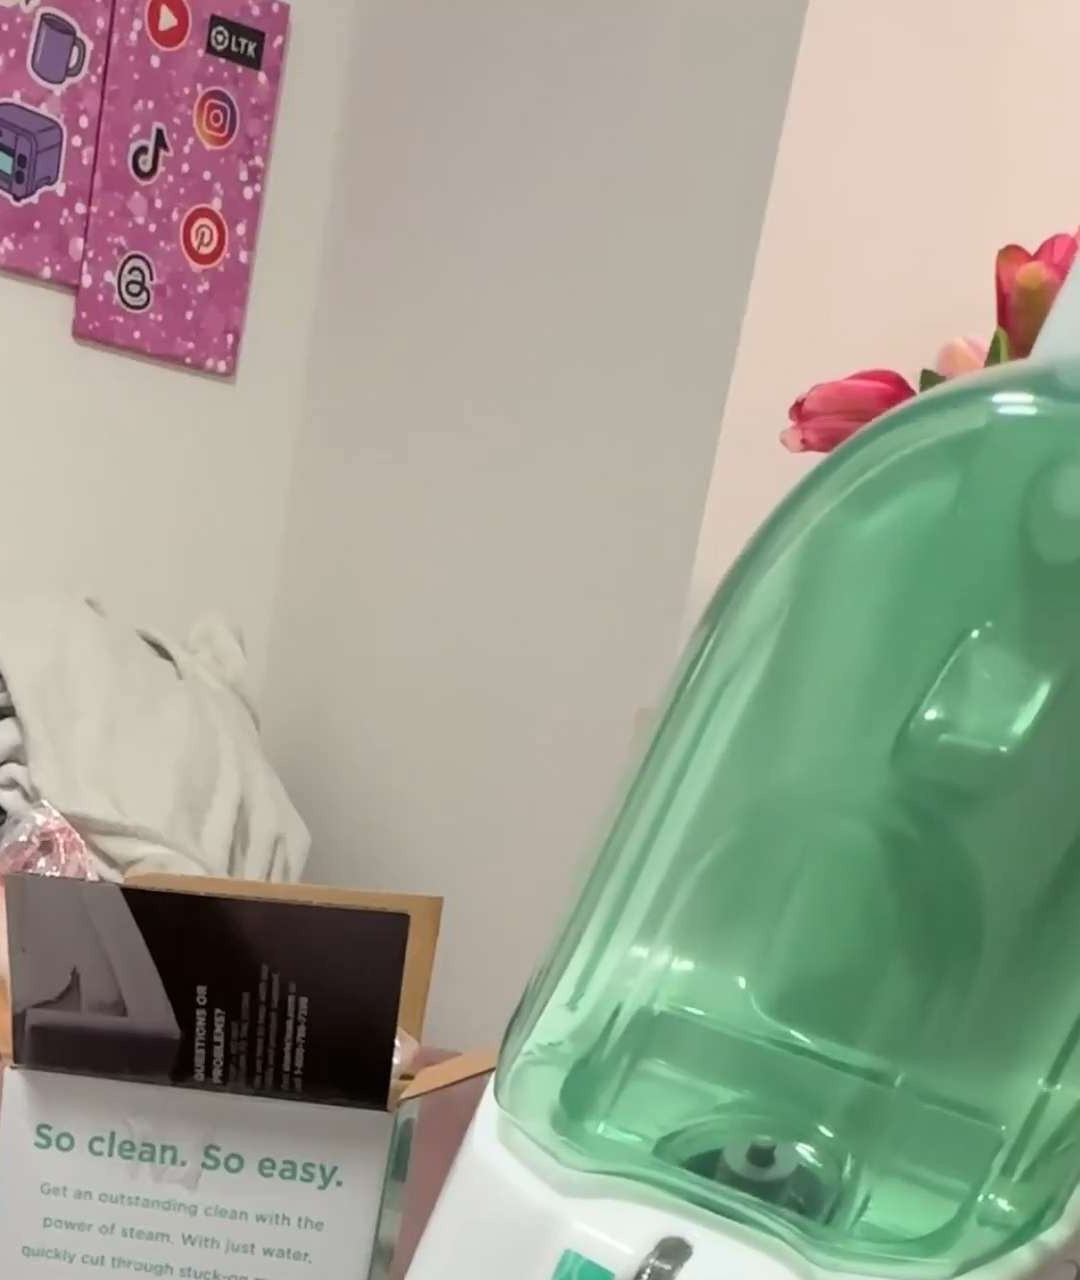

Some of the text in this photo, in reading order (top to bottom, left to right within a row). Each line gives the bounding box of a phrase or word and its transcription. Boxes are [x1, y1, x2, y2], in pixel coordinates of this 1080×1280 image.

[231, 35, 257, 58] LTK
[33, 1123, 343, 1190] So clean. So easy.
[40, 1182, 325, 1232] Get an outstanding clean with the
[42, 1215, 94, 1233] power
[98, 1222, 116, 1236] of
[121, 1225, 173, 1244] steam.
[181, 1232, 221, 1249] With
[224, 1238, 256, 1256] just
[21, 1245, 77, 1264] quickly
[81, 1253, 105, 1267] cut
[110, 1256, 174, 1278] through
